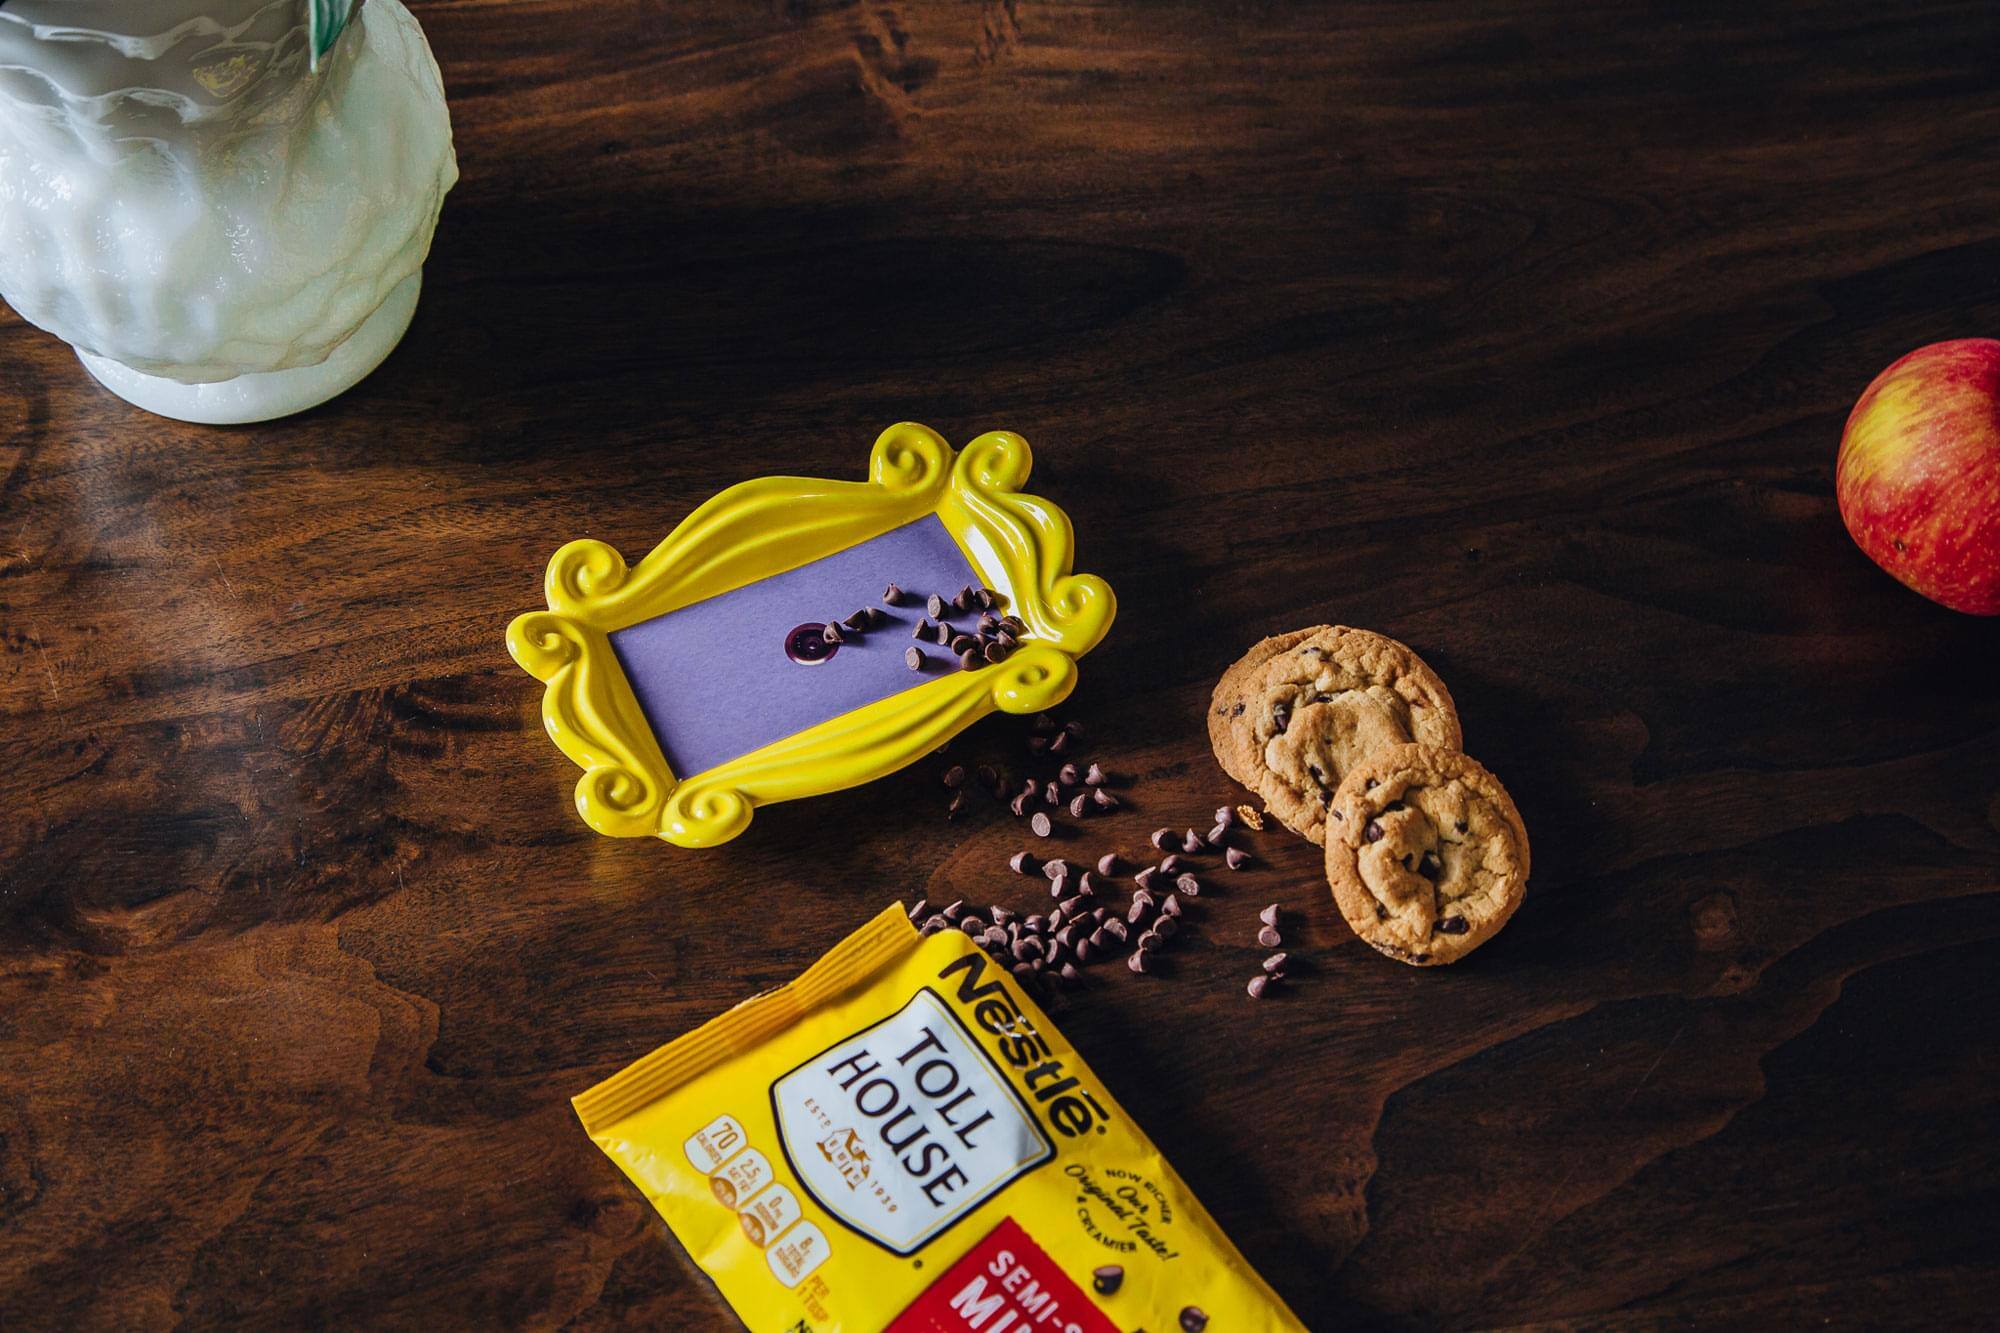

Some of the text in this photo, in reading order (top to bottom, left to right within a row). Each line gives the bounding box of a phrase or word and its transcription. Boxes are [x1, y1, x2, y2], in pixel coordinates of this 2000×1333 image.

[938, 952, 1110, 1138] Nestlé
[896, 1026, 995, 1149] TOLL
[711, 1122, 739, 1150] 70
[827, 1049, 969, 1207] HOUSE
[1064, 1164, 1179, 1261] Original Taste!
[1077, 1208, 1137, 1253] CREAMIER
[1105, 1168, 1172, 1224] NOW RICHER
[1116, 1186, 1149, 1214] Our
